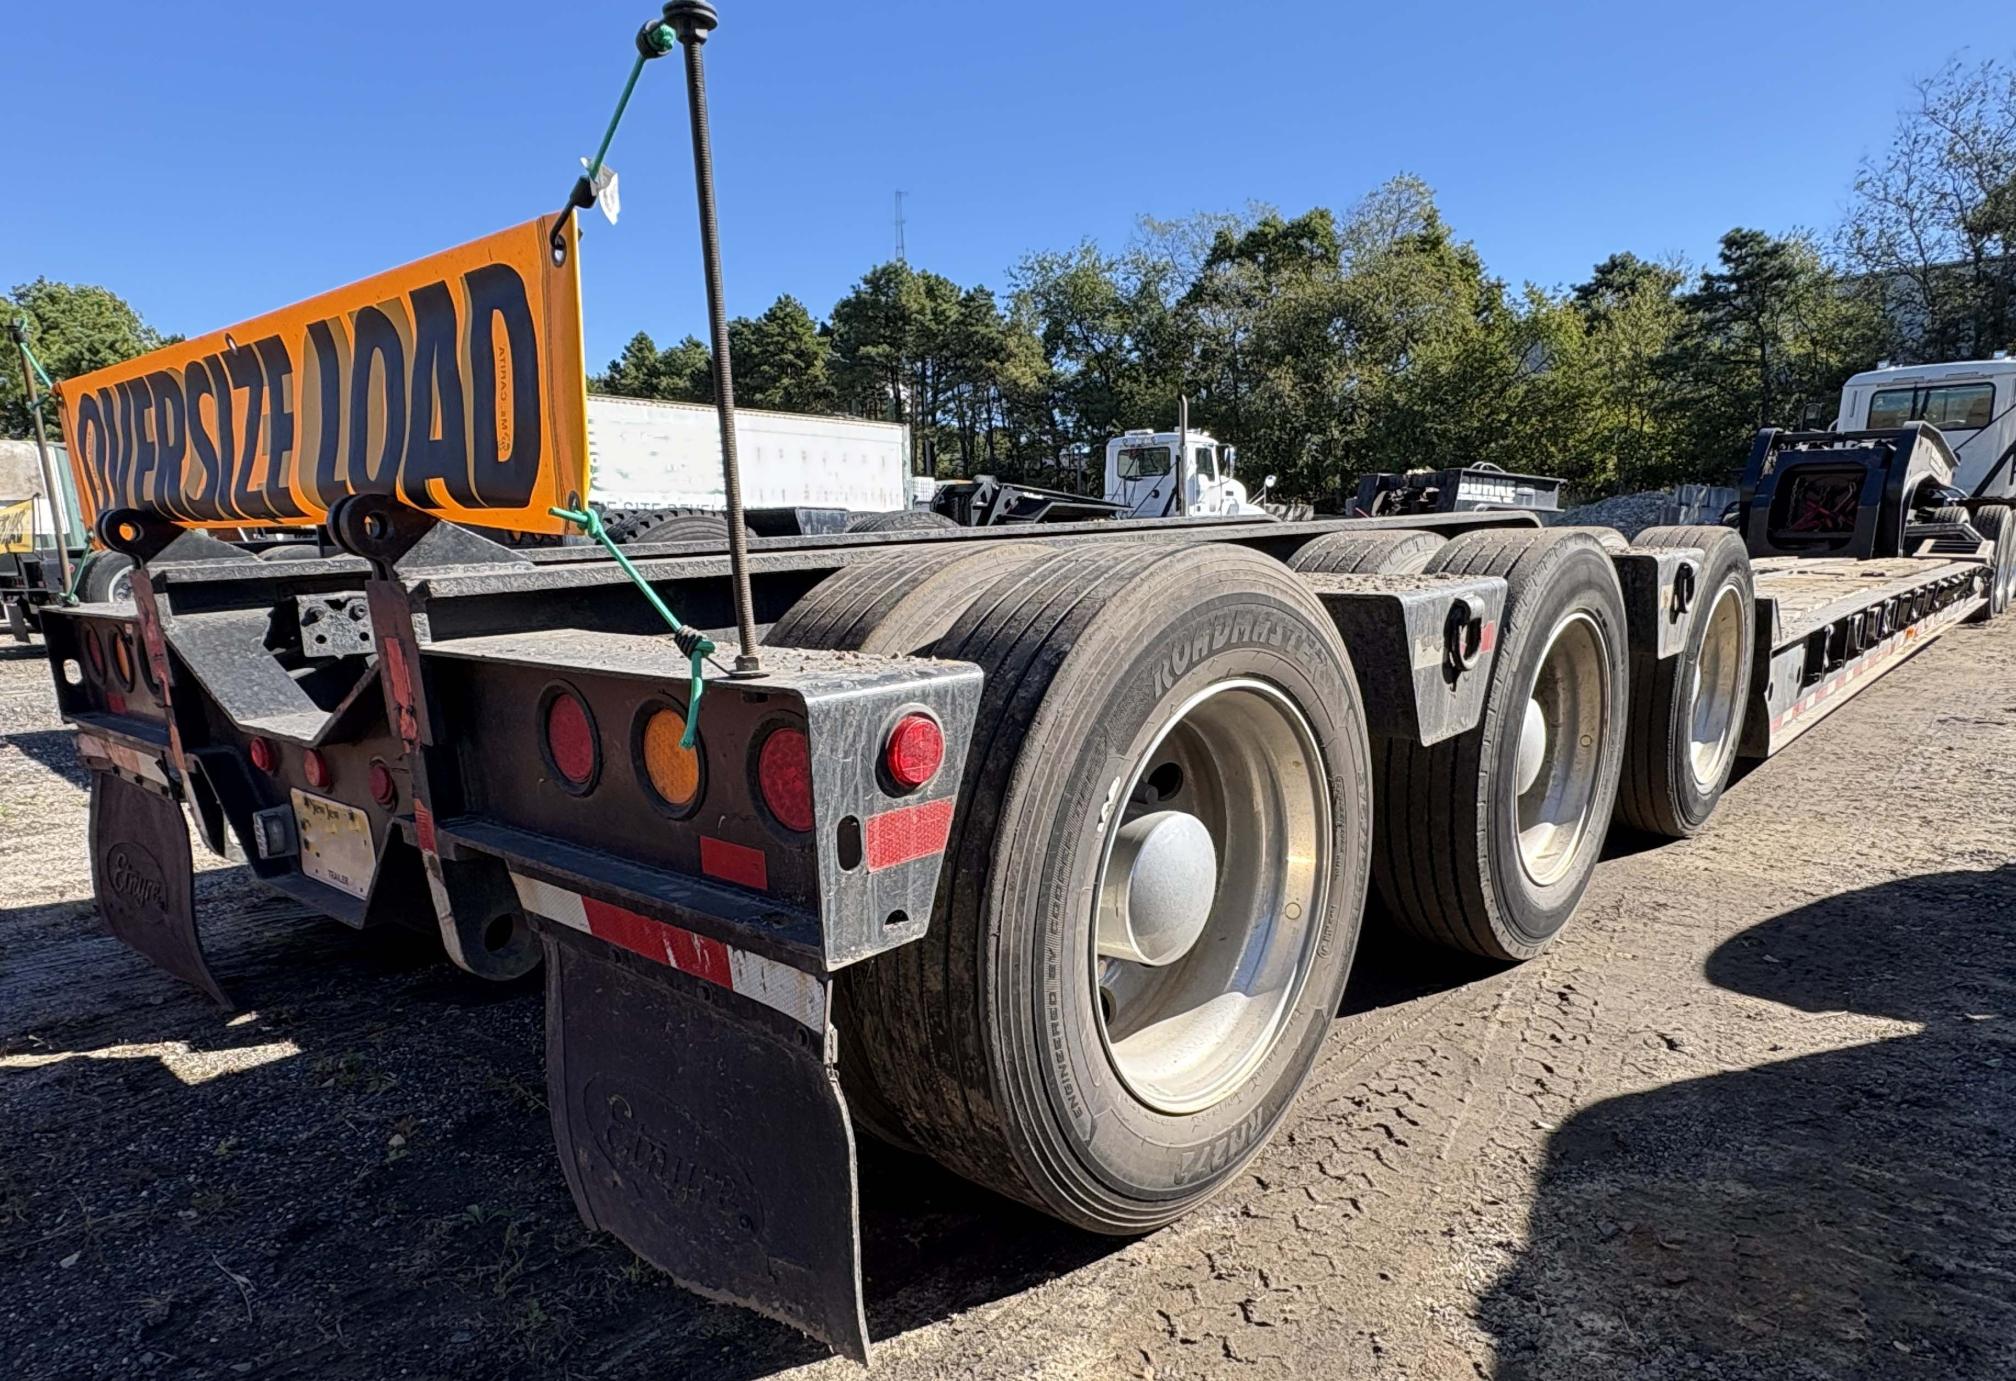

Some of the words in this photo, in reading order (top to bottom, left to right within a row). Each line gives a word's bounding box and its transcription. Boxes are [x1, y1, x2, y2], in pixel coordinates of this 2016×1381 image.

[78, 335, 309, 521] OVERSIZE
[305, 264, 541, 508] LOAD
[1048, 990, 1083, 1119] ENGINEERED
